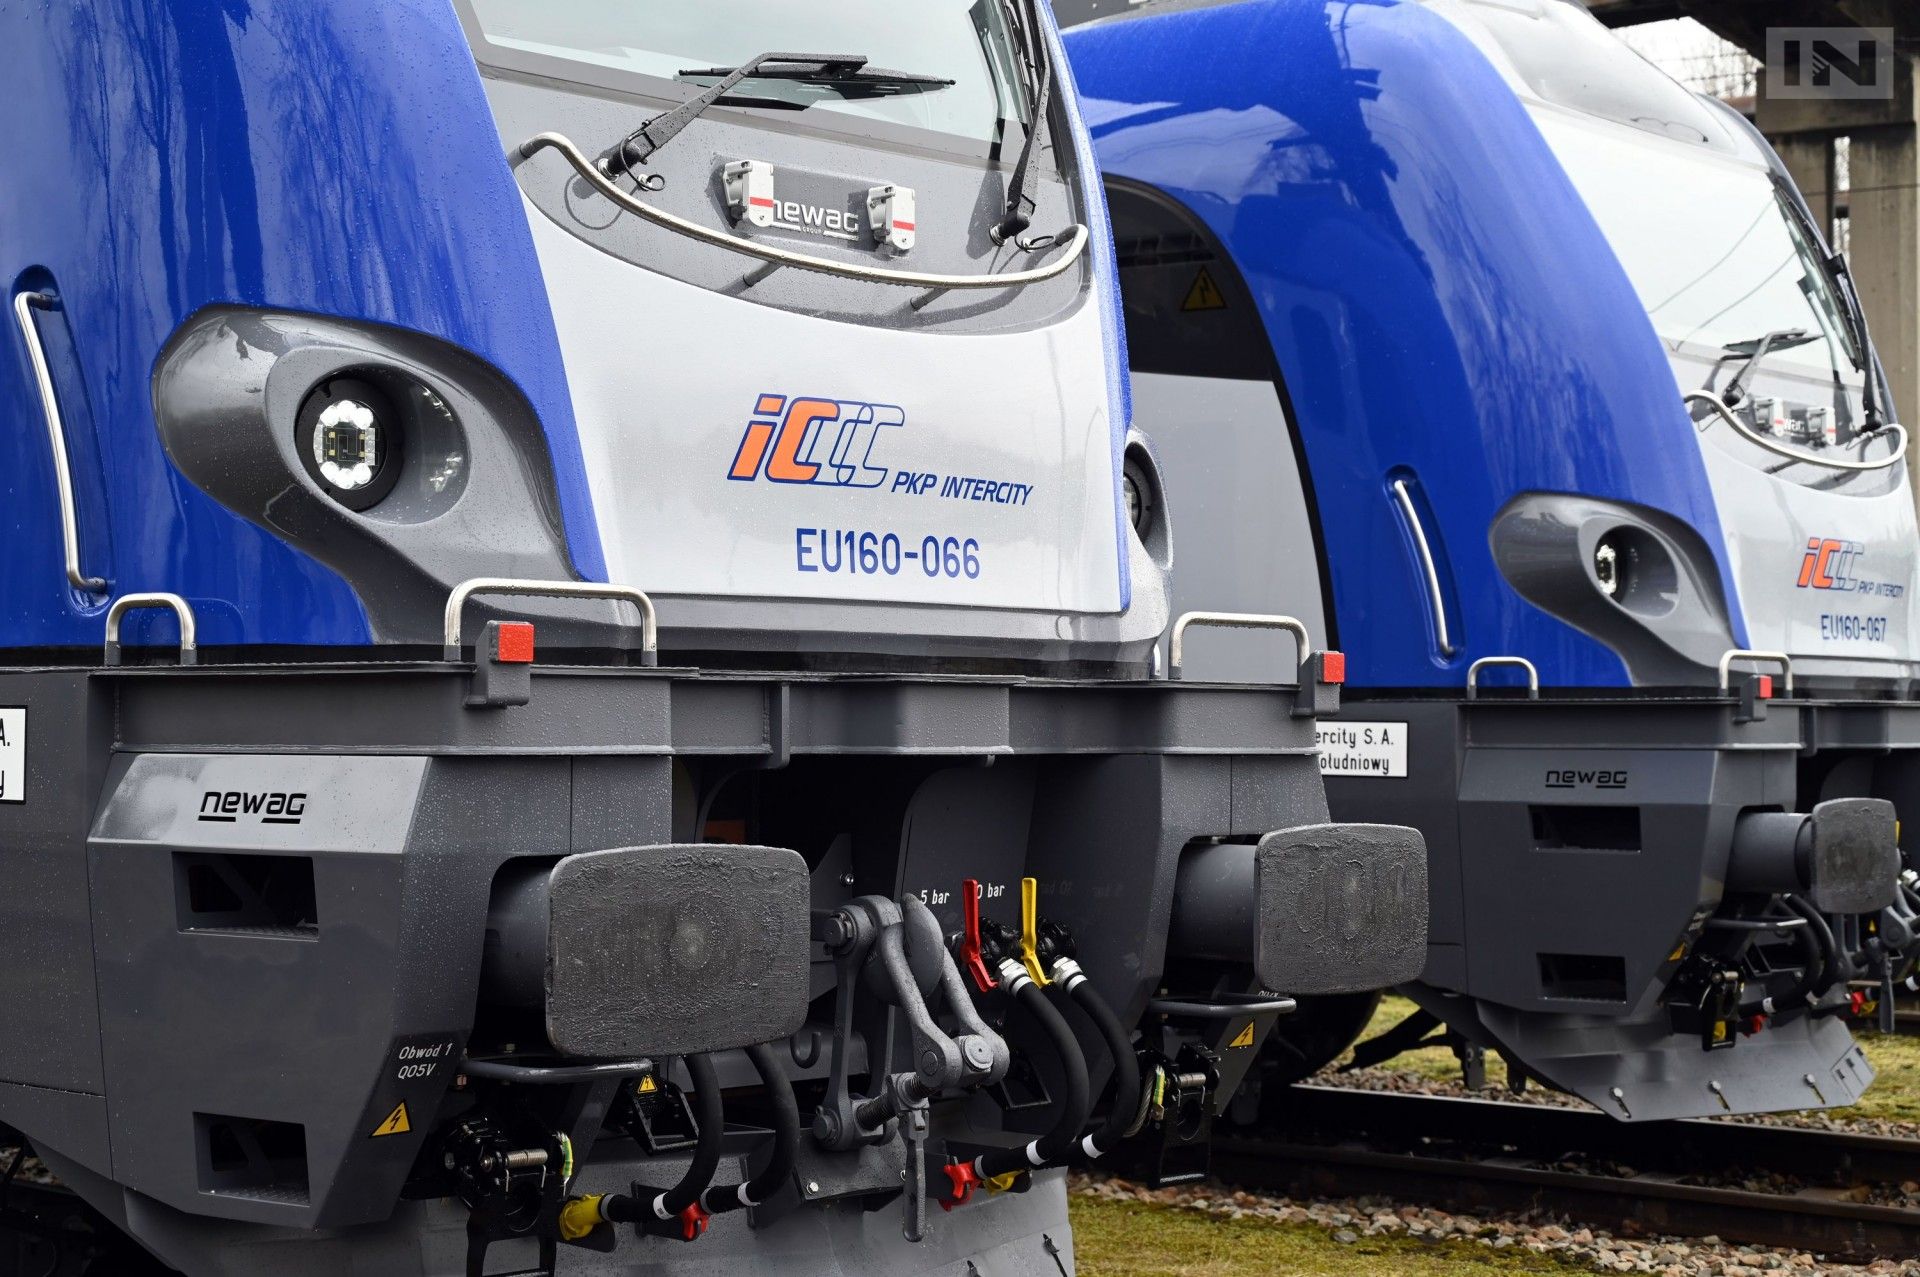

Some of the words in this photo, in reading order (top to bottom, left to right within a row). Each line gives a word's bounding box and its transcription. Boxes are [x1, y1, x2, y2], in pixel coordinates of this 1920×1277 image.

[891, 471, 937, 496] PKP
[940, 476, 1034, 506] INTERCITY
[796, 527, 980, 580] EU160-066
[1821, 614, 1887, 642] EU160-067
[1315, 728, 1356, 748] ercity
[1320, 753, 1389, 775] ołudniowy
[932, 889, 950, 905] bar
[987, 882, 1005, 898] bar
[399, 1043, 442, 1060] Obwód
[445, 1042, 453, 1056] 1
